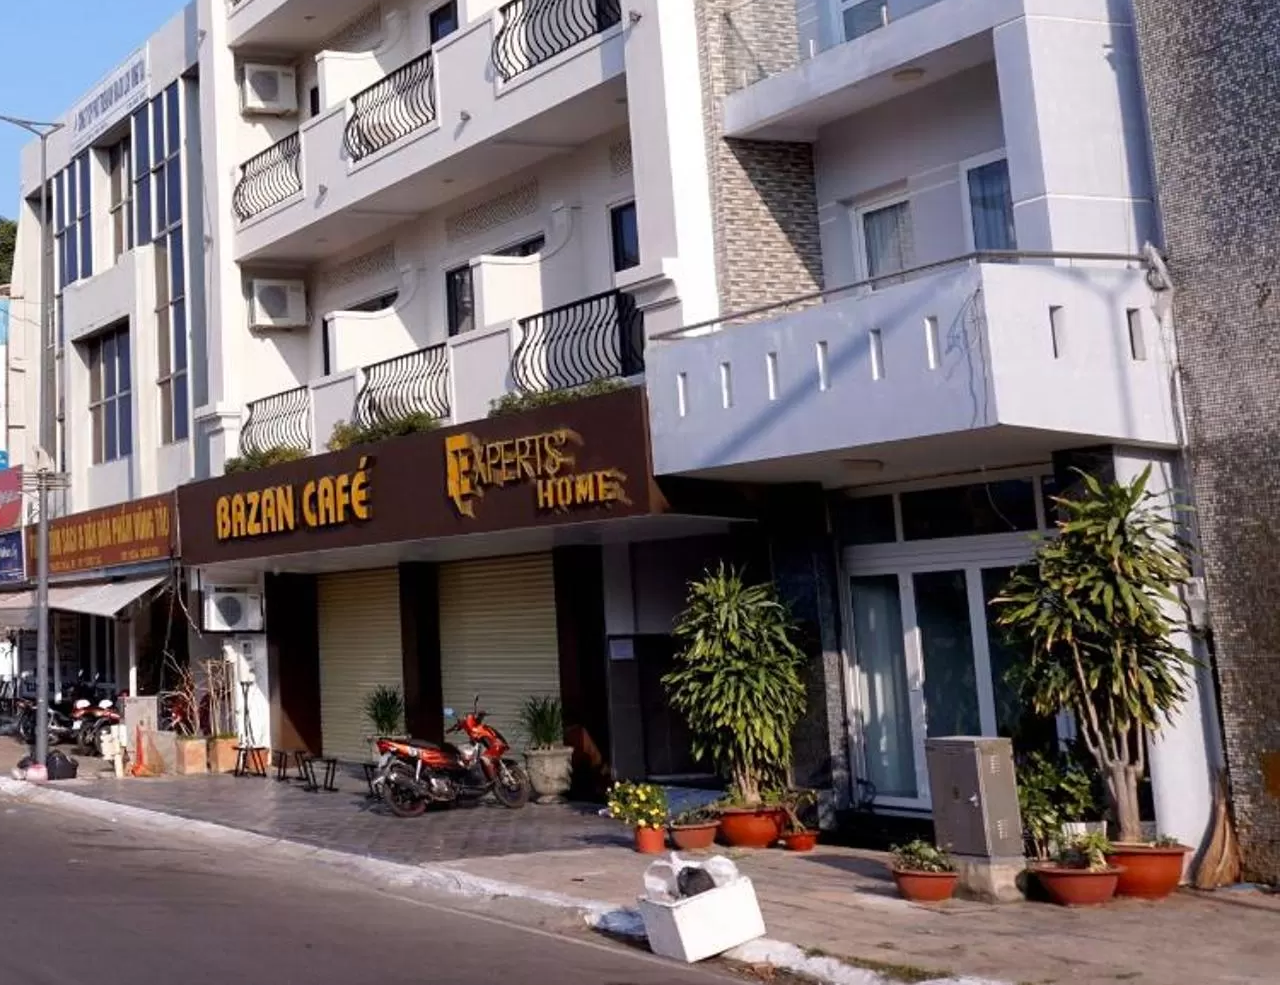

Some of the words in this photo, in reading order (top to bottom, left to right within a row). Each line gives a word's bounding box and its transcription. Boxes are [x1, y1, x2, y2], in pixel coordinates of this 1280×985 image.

[217, 477, 295, 539] BAZAN
[303, 456, 370, 527] CAFÉ
[537, 470, 618, 509] HOME
